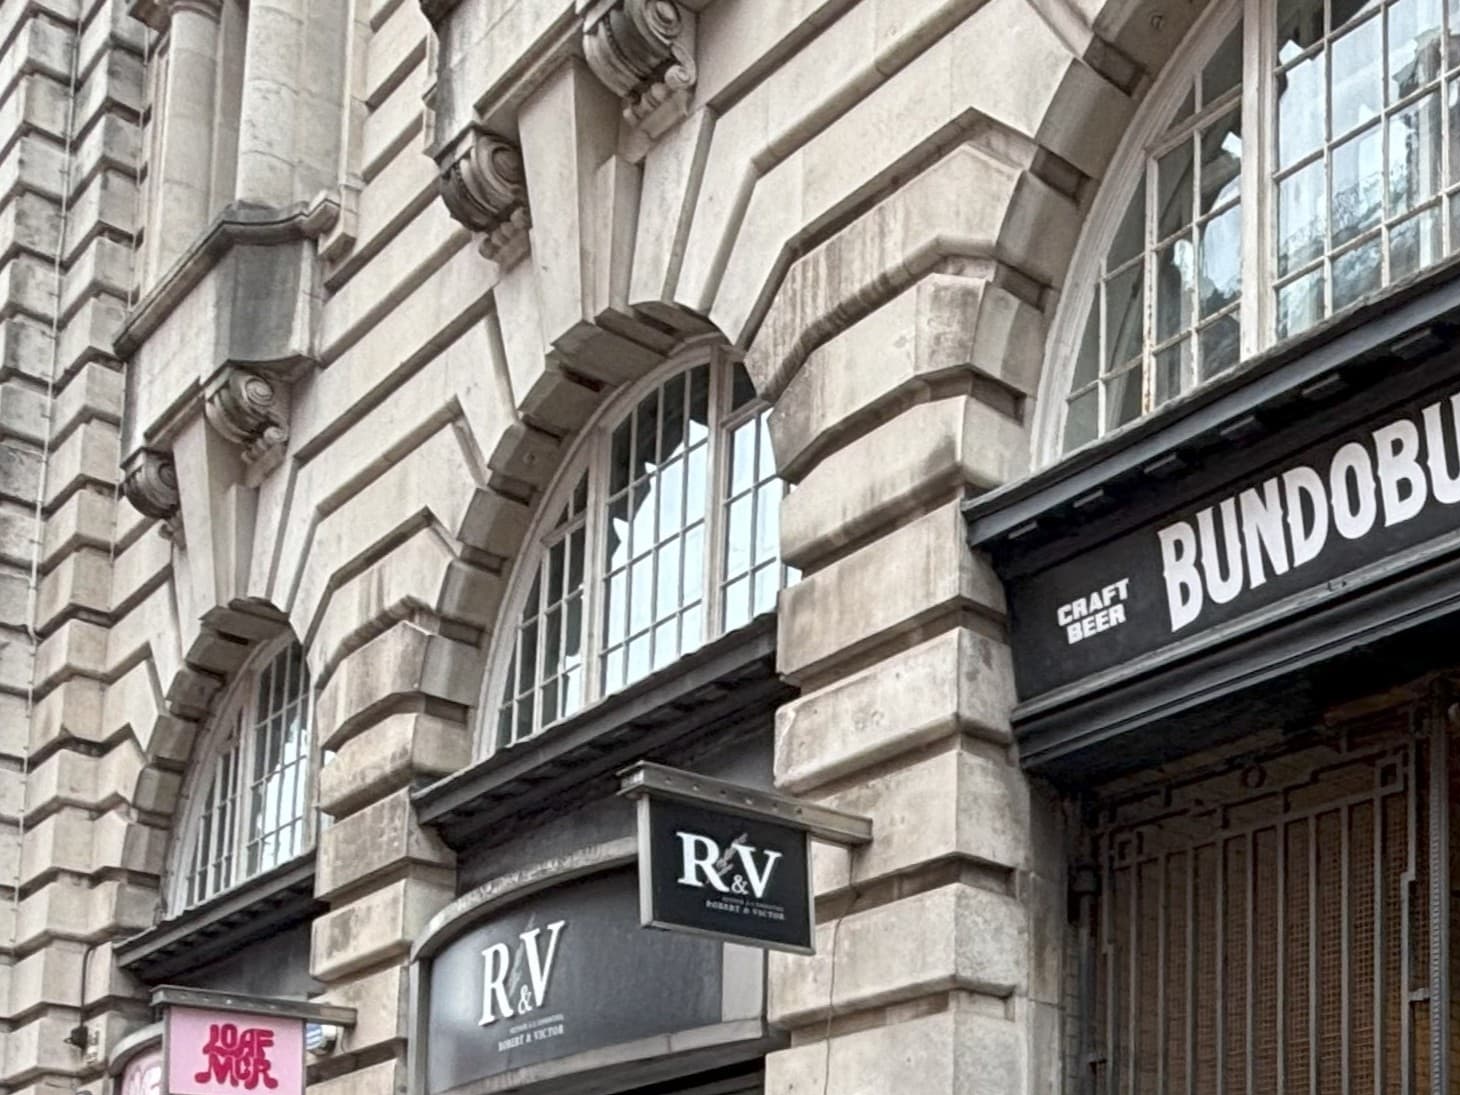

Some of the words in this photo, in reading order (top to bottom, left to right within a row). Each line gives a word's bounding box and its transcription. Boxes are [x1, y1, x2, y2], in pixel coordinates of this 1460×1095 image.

[1057, 578, 1129, 627] CRAFT
[1066, 603, 1127, 645] BEER
[203, 1024, 274, 1060] LOAF
[195, 1053, 278, 1090] MCR
